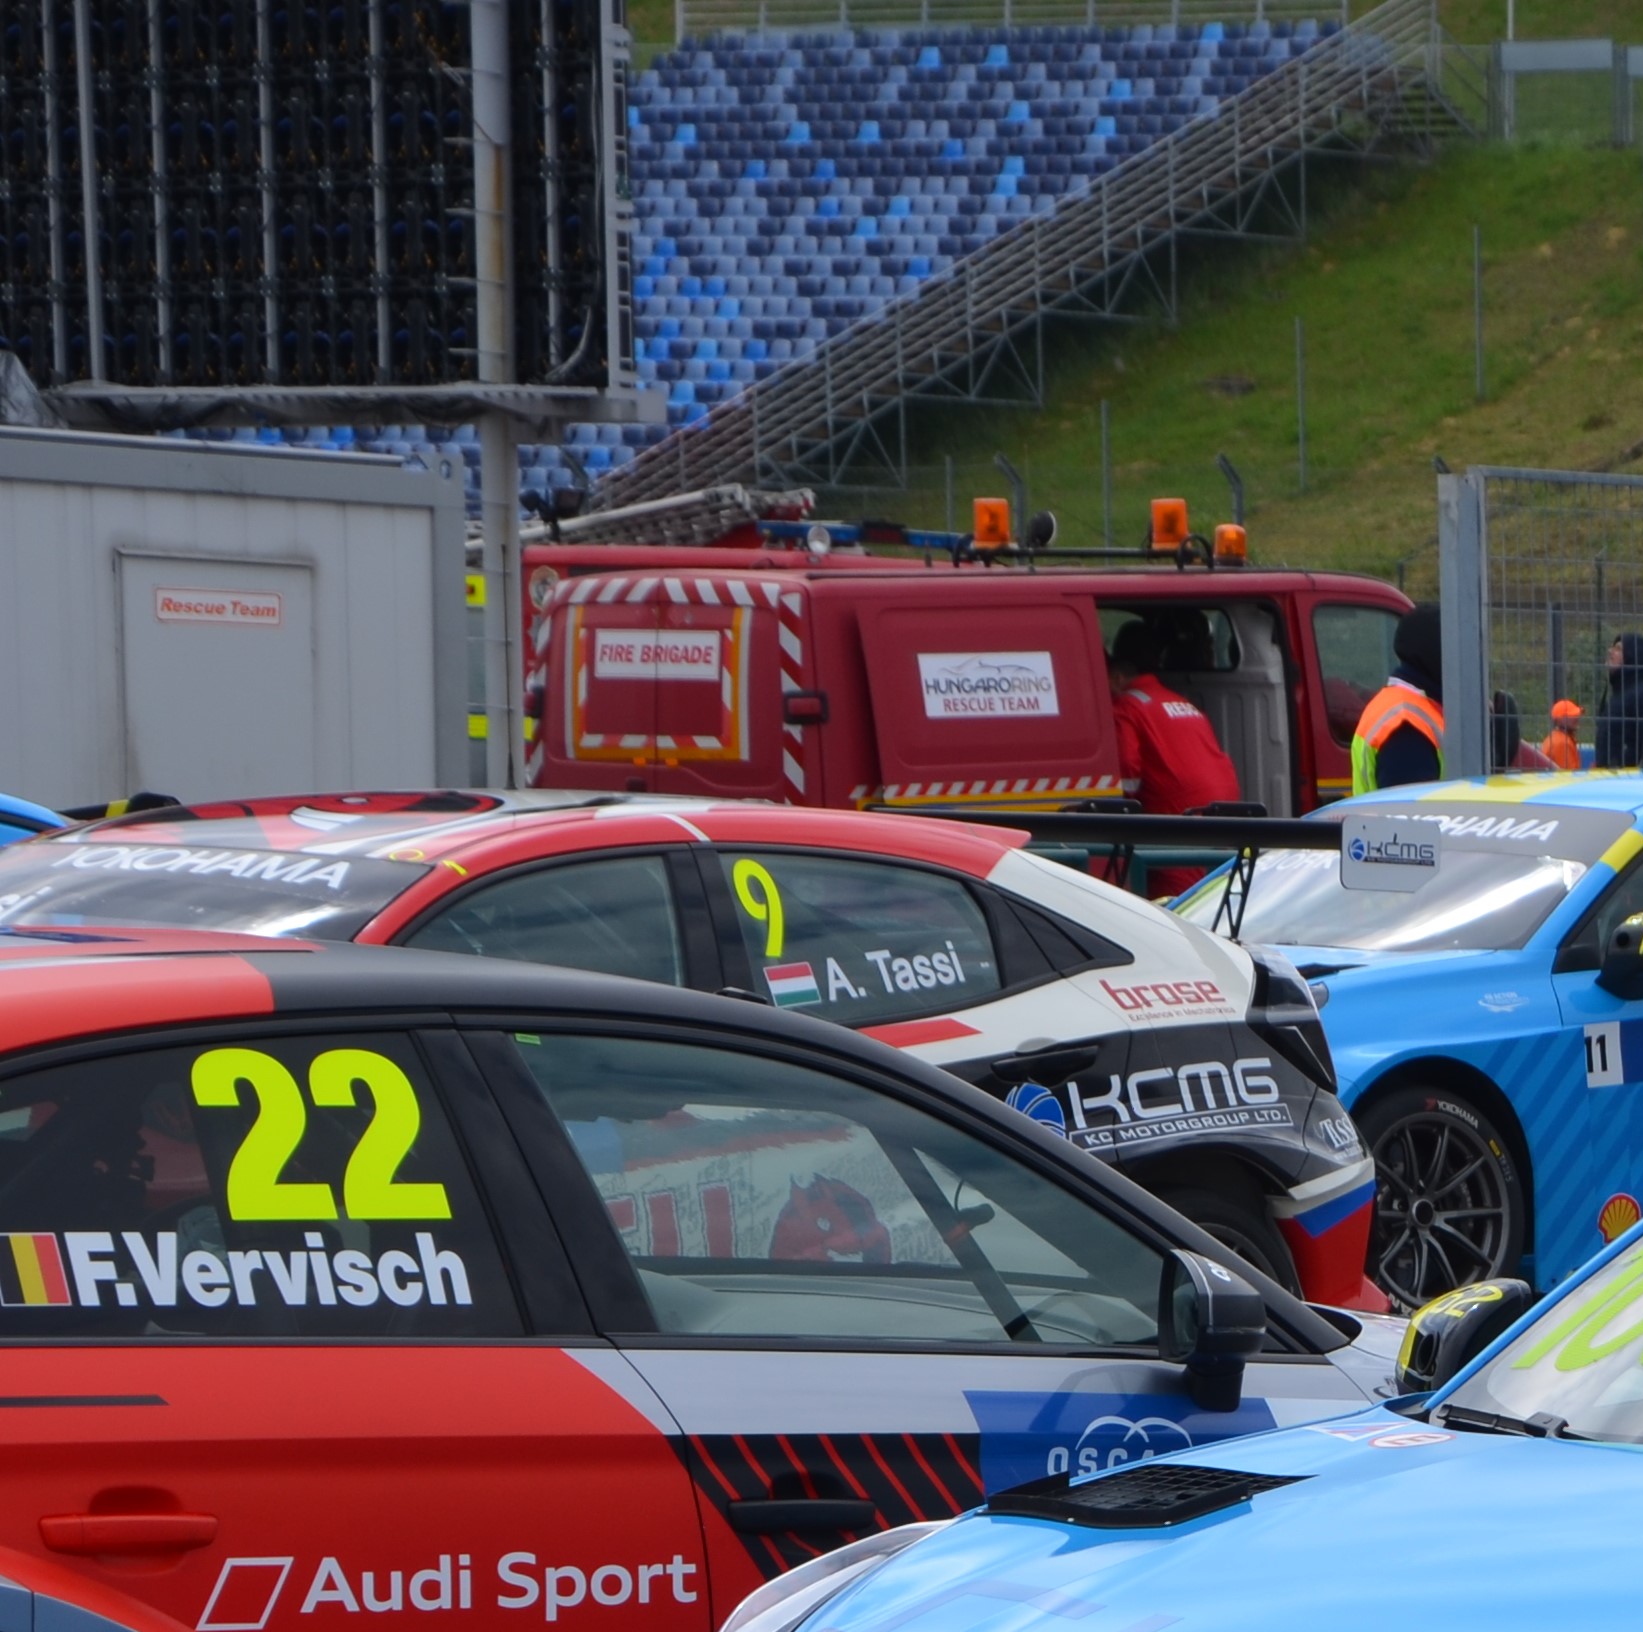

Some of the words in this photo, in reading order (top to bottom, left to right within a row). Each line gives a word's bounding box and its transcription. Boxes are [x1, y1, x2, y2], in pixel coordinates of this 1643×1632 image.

[161, 597, 226, 615] Rescue
[230, 600, 276, 617] Team
[600, 644, 634, 664] FIRE
[640, 644, 714, 664] BRIGADE
[924, 676, 1052, 695] HUNGARORING
[944, 697, 996, 712] RESCUE
[1000, 696, 1040, 712] TEAM
[51, 846, 352, 890] YOKOHAMA
[1366, 841, 1435, 859] KCMG
[732, 858, 783, 958] 9
[824, 958, 867, 1004] A.
[866, 939, 966, 992] Tassi
[1098, 978, 1227, 1011] brose
[1067, 1057, 1281, 1130] KCMG
[190, 1047, 453, 1222] 22
[1084, 1131, 1115, 1147] KC
[1118, 1111, 1251, 1142] MOTORGROUP
[1252, 1107, 1288, 1125] LTD.
[1437, 1100, 1479, 1129] YOKOHAMA
[63, 1230, 473, 1307] F.Vervisch
[300, 1552, 472, 1614] Audi
[496, 1551, 698, 1622] Sport
